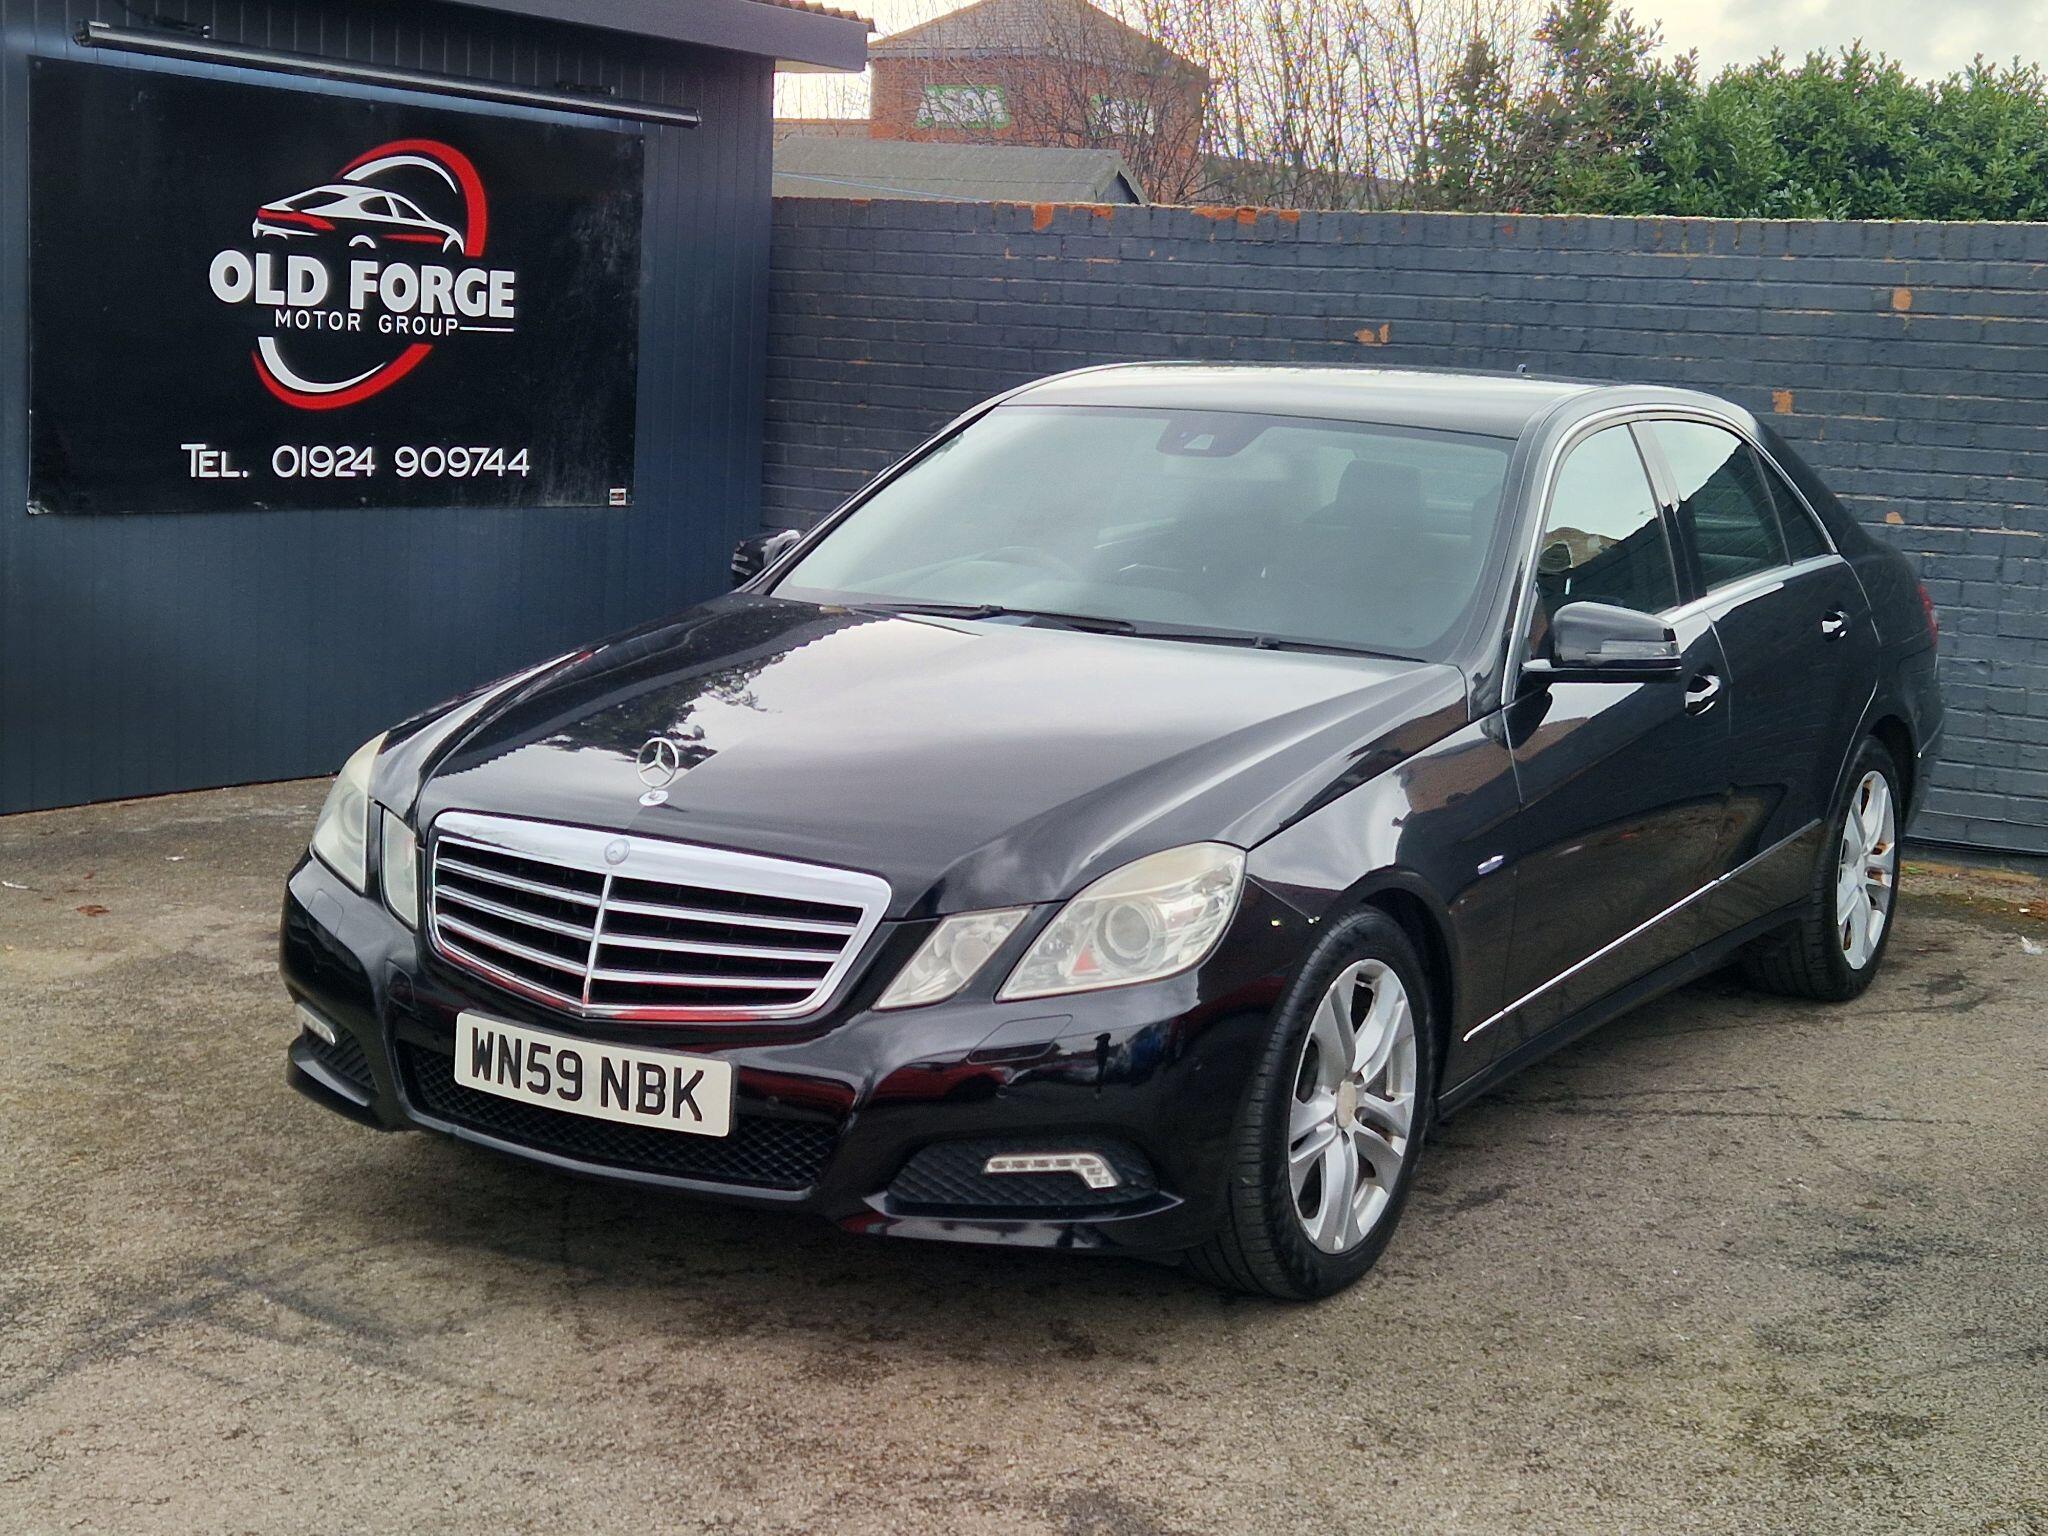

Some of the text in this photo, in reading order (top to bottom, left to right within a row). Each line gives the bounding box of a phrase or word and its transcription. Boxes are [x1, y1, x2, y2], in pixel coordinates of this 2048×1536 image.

[209, 249, 515, 318] OLD FORGE
[275, 309, 459, 336] MOTOR GROUP
[180, 443, 530, 478] TEL. 01924 909744
[471, 1026, 704, 1122] WN59 NBK
